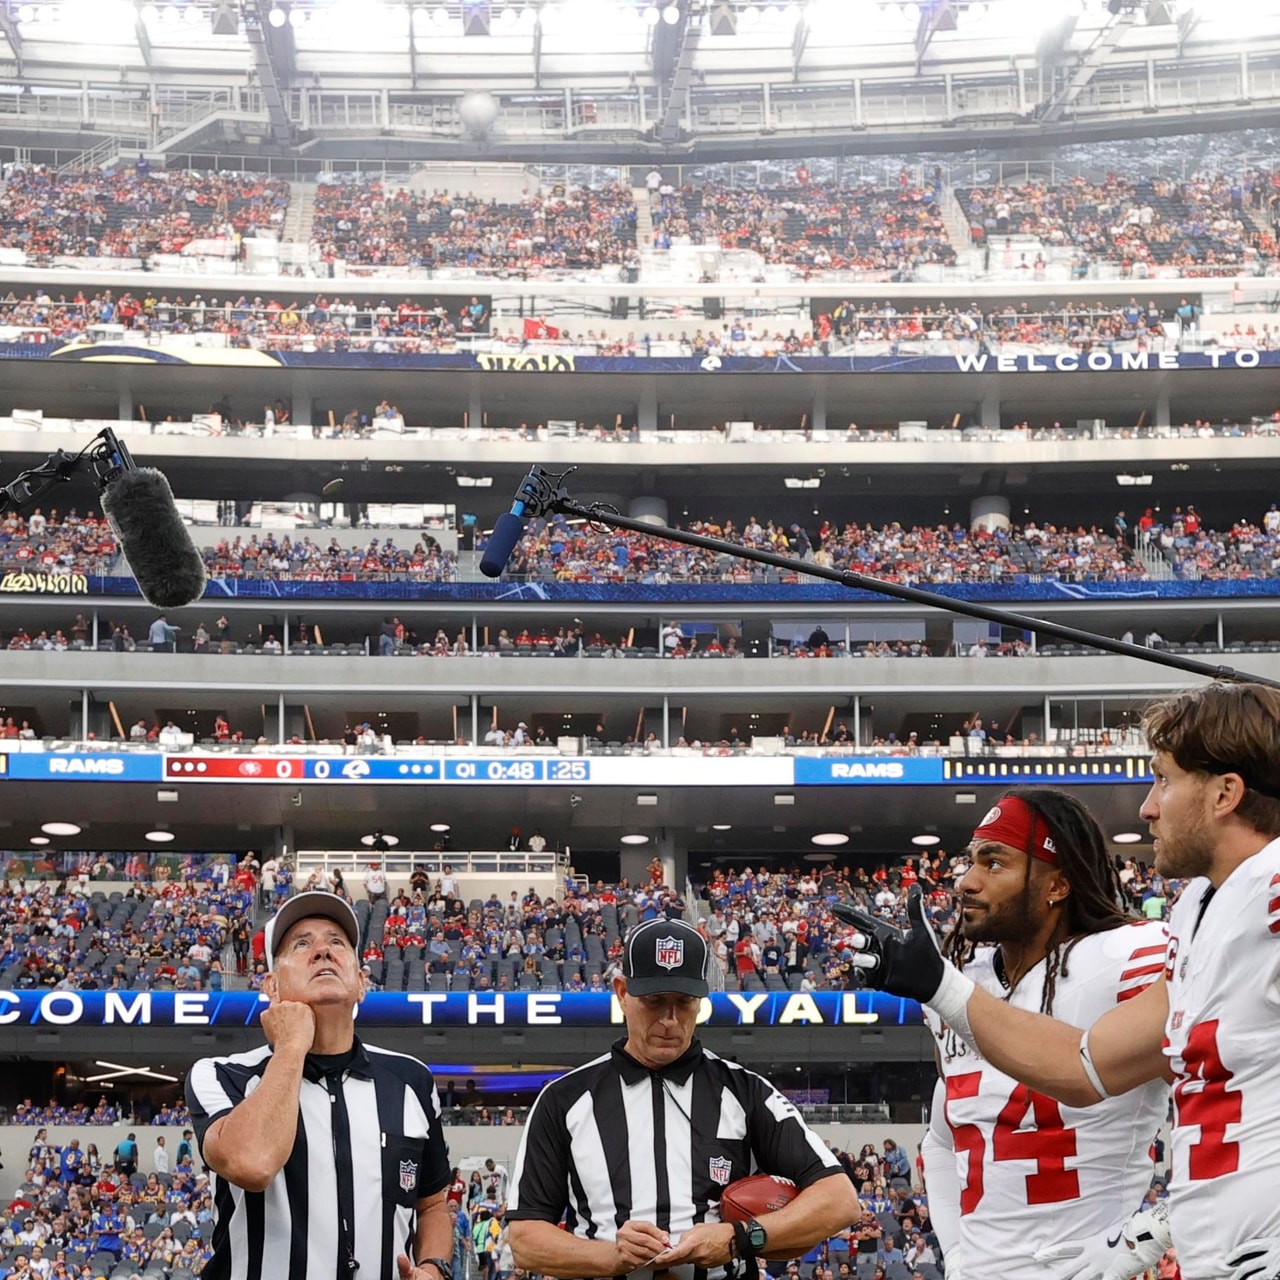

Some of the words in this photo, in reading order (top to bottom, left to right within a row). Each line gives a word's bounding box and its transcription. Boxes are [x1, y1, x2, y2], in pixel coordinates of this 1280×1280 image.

[955, 350, 1180, 372] WELCOME
[1204, 349, 1261, 368] TO
[49, 757, 125, 775] RAMS
[277, 760, 292, 779] 0
[314, 760, 330, 779] 0
[487, 761, 536, 780] 0:48
[551, 761, 588, 780] :25
[830, 762, 904, 779] RAMS
[407, 993, 562, 1025] THE
[944, 1070, 1081, 1217] 54
